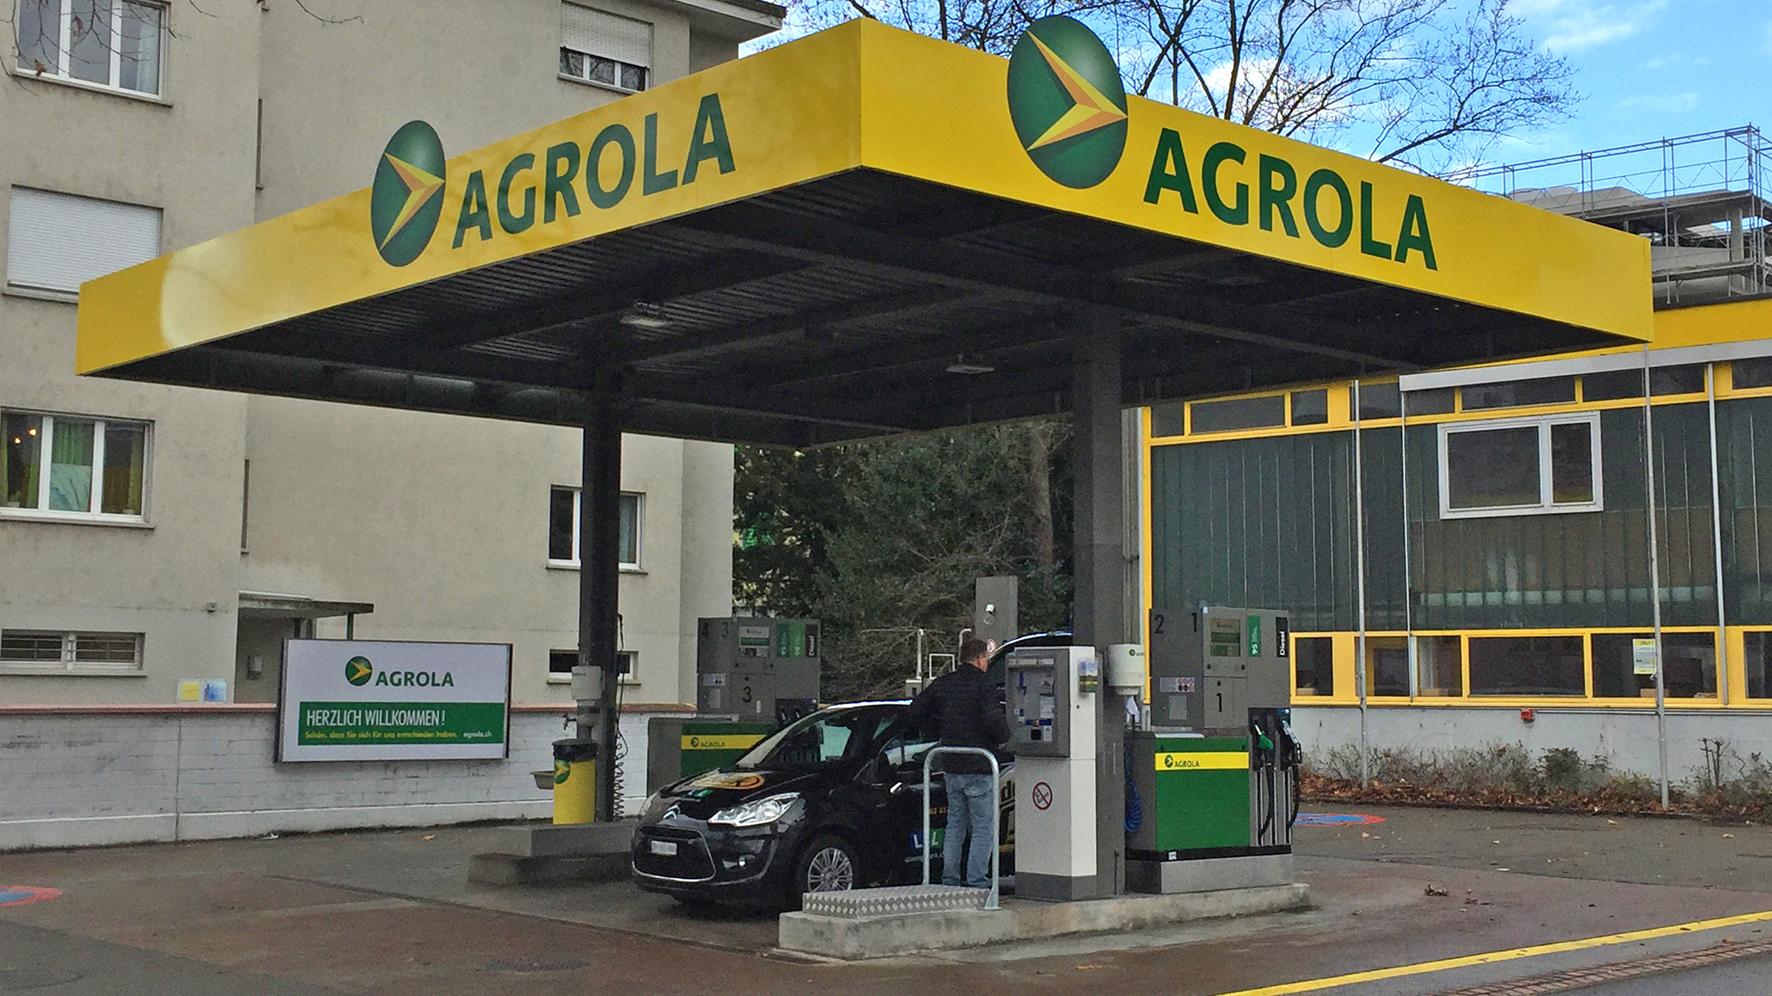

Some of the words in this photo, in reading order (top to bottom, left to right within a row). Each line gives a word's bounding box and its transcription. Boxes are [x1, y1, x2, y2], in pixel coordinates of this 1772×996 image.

[451, 92, 736, 250] AGROLA
[1143, 127, 1438, 271] AGROLA
[1154, 614, 1165, 634] 2
[1191, 612, 1198, 633] 1
[375, 671, 455, 687] AGROLA
[743, 686, 753, 703] 3
[1216, 693, 1222, 713] 1
[306, 709, 362, 726] HERZLICH
[1174, 760, 1200, 768] AGROLA
[913, 834, 923, 848] L
[931, 831, 939, 846] L
